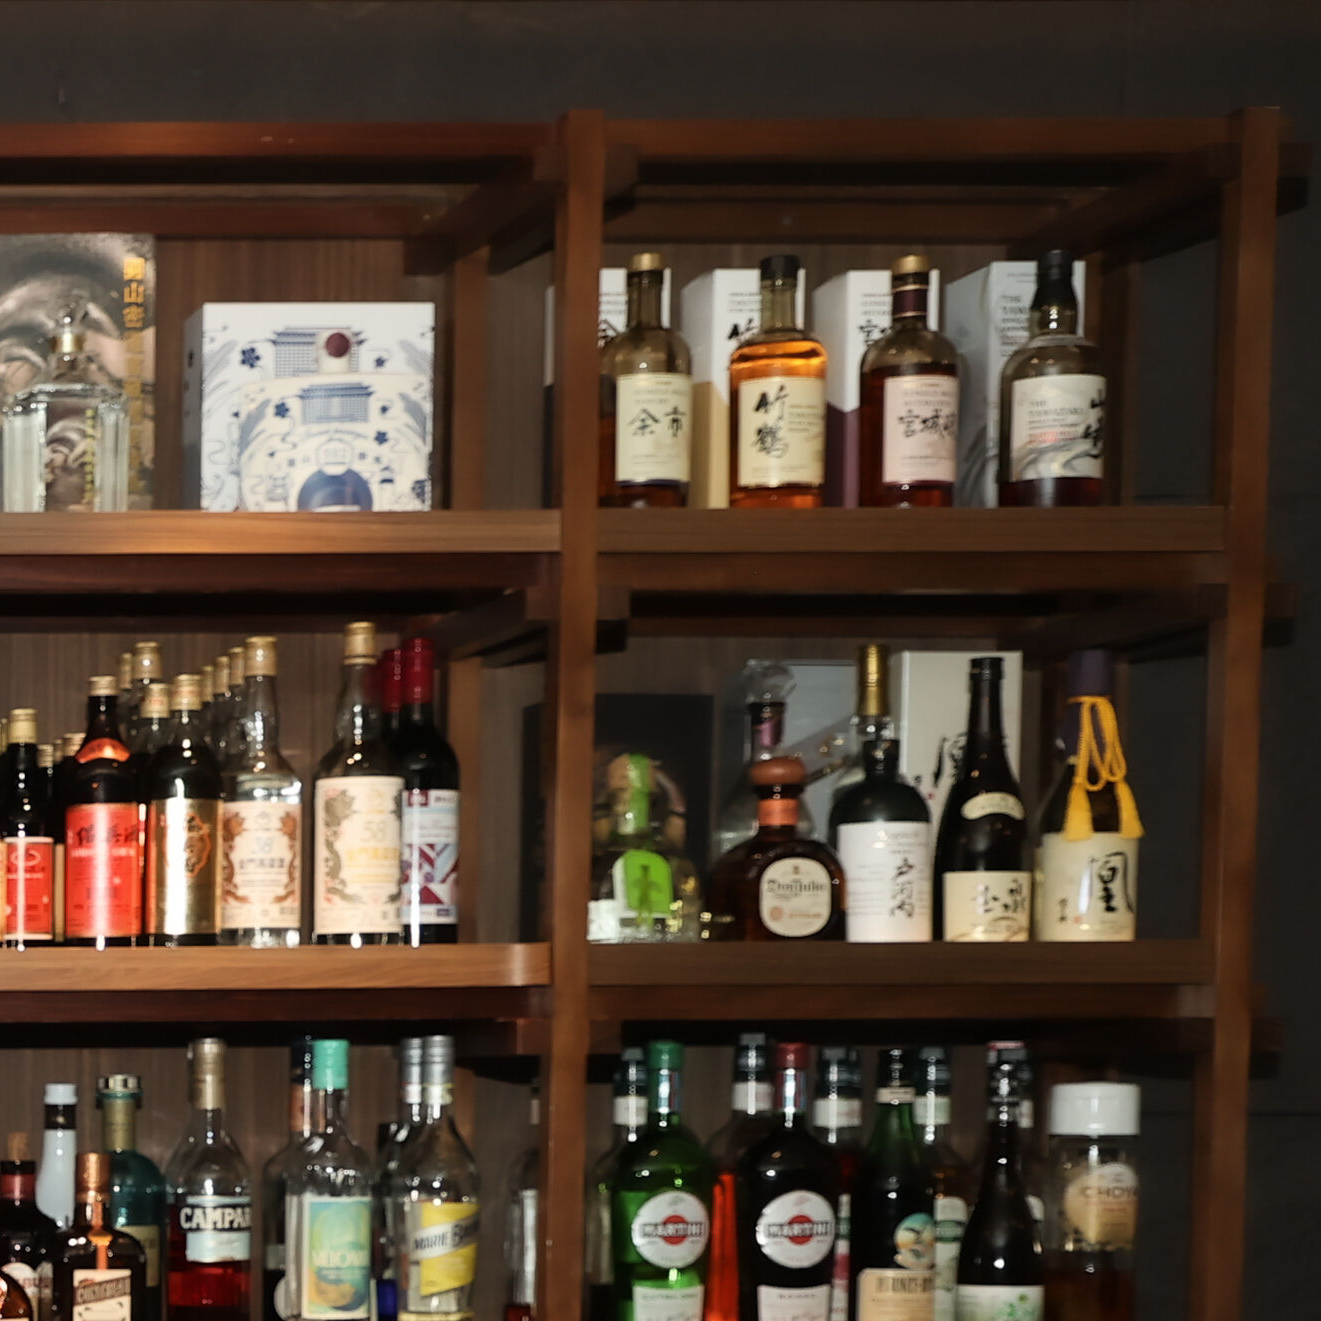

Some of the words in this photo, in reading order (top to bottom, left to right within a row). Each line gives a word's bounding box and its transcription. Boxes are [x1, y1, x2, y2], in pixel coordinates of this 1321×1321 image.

[628, 405, 687, 441] 余市
[754, 383, 790, 459] 竹鶴
[643, 1222, 704, 1238] MARTINI
[768, 1222, 831, 1238] MARTINI
